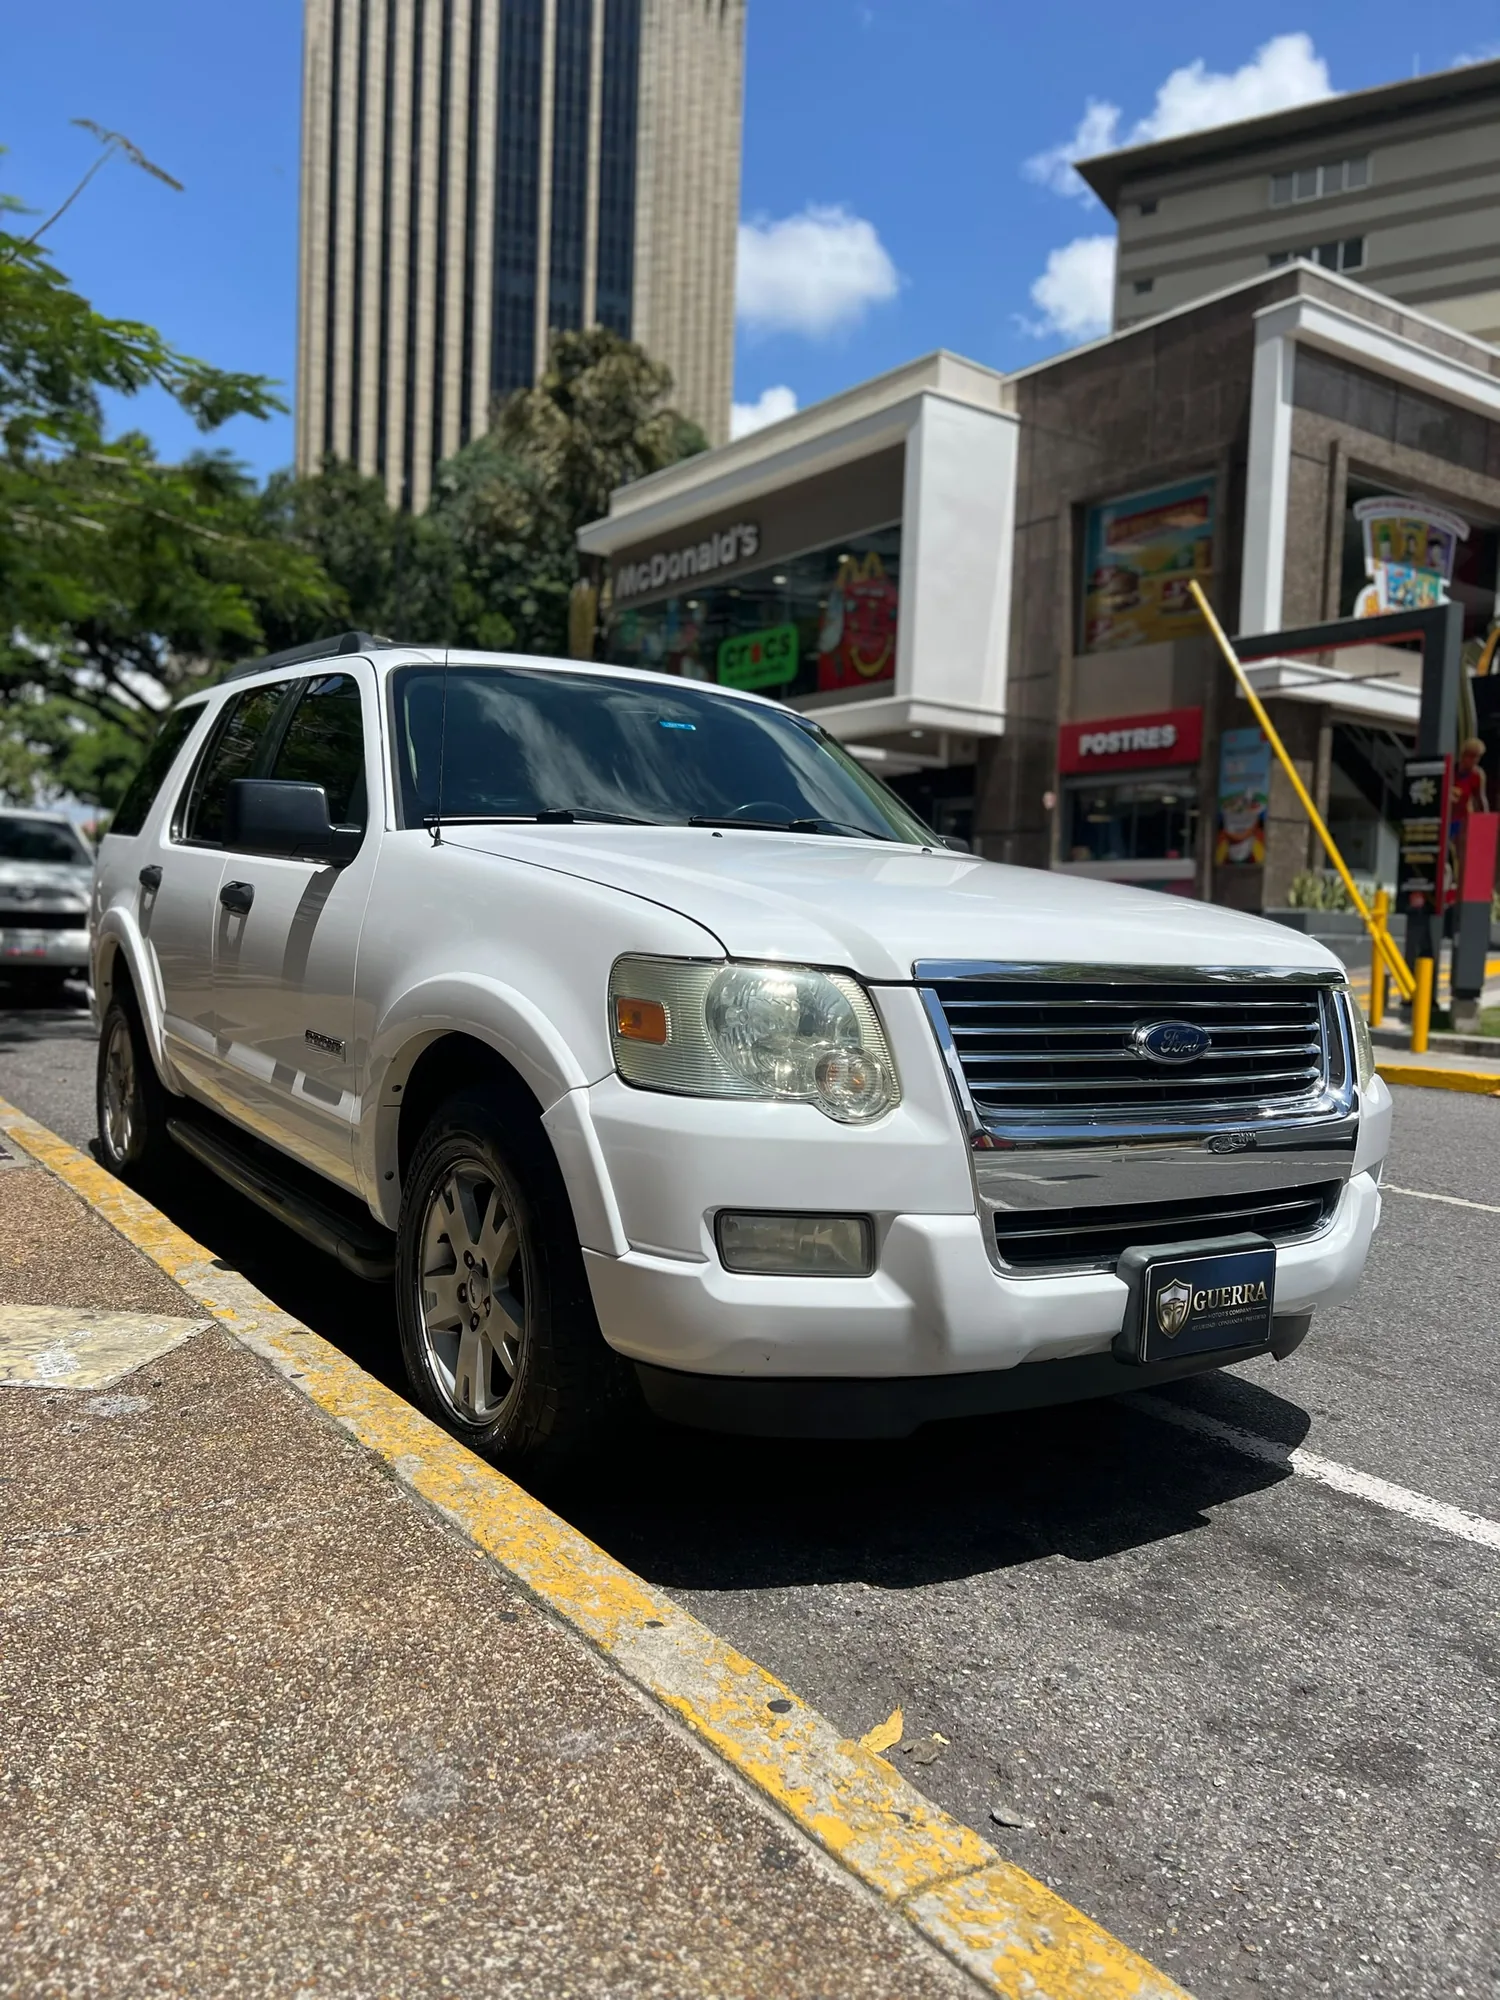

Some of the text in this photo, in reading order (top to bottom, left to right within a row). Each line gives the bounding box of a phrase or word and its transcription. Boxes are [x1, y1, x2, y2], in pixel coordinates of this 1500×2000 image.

[615, 523, 759, 599] McDonald's
[1078, 724, 1177, 756] POSTRES
[1159, 1029, 1201, 1053] Ford
[1193, 1280, 1268, 1312] GUERRA
[1229, 1306, 1252, 1316] COMPANY
